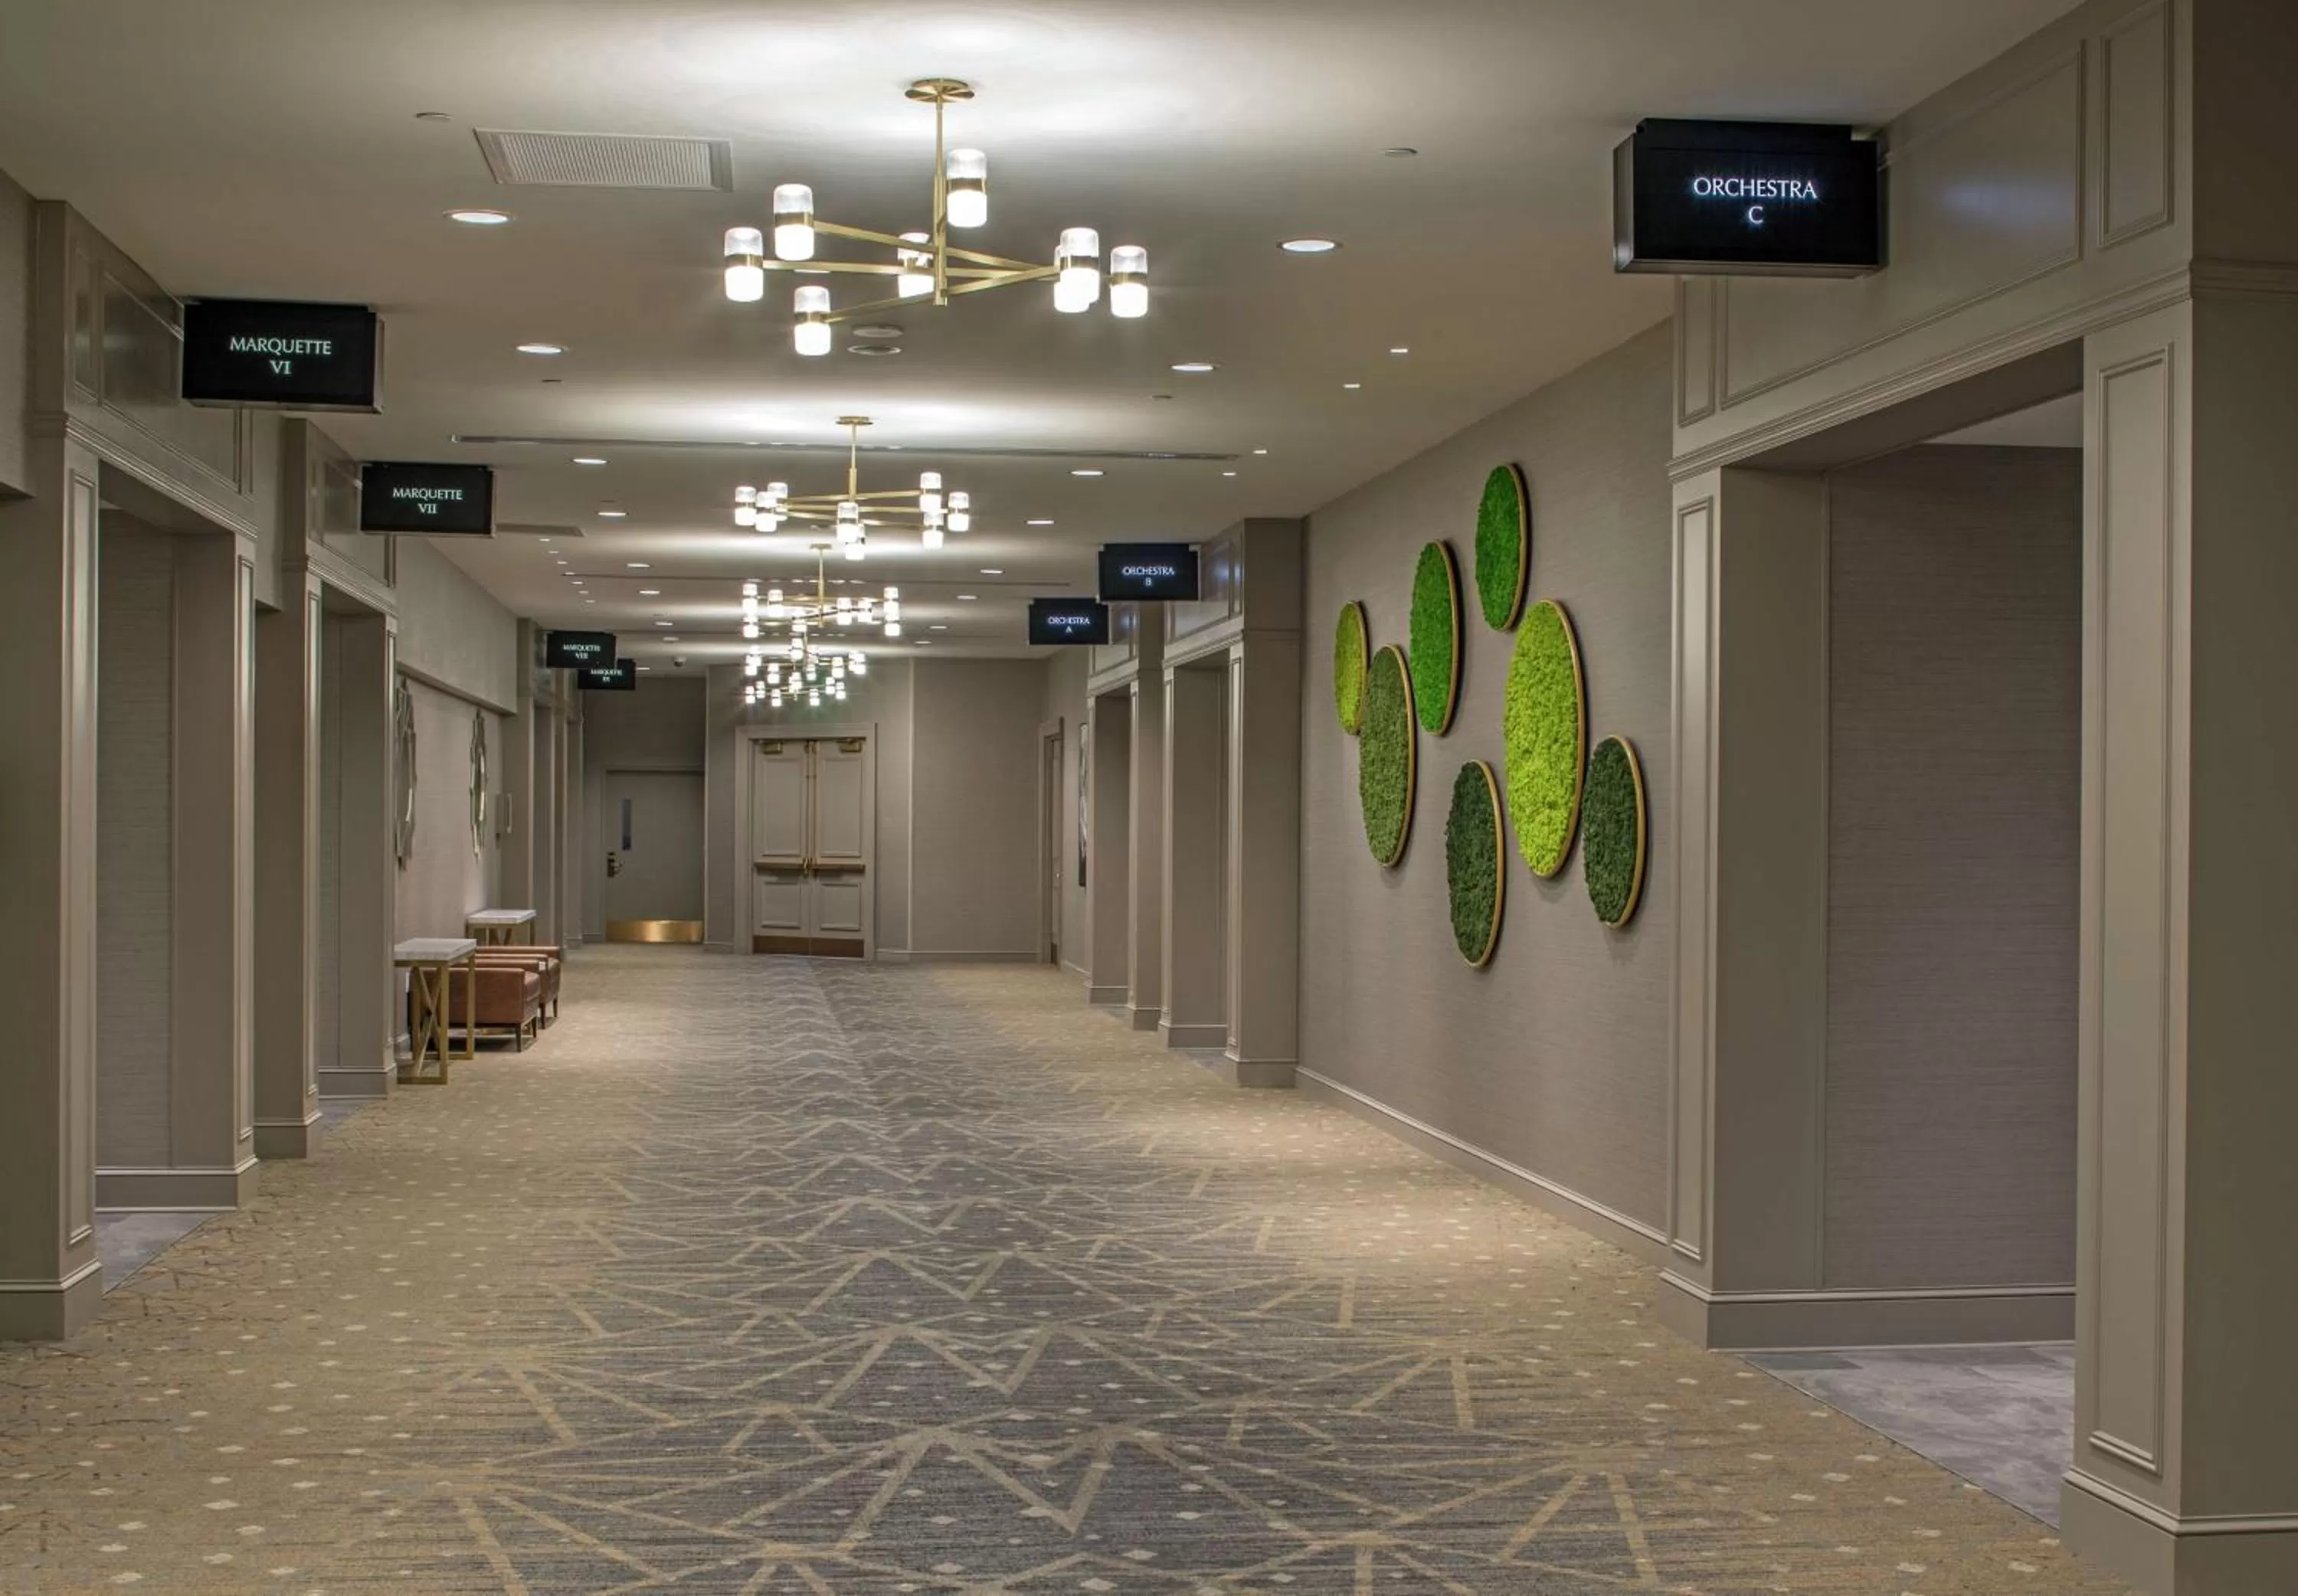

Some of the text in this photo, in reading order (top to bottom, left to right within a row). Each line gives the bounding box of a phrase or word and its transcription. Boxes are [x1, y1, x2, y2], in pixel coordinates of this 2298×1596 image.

[1693, 176, 1818, 200] ORCHESTRA
[1747, 205, 1764, 225] C
[230, 335, 332, 356] MARQUETTE
[270, 360, 292, 374] VI
[393, 488, 464, 502] MARQUETTE
[417, 503, 438, 515] VII
[1122, 566, 1176, 576] ORCHESTRA
[1047, 616, 1091, 625] ORCHESTRA
